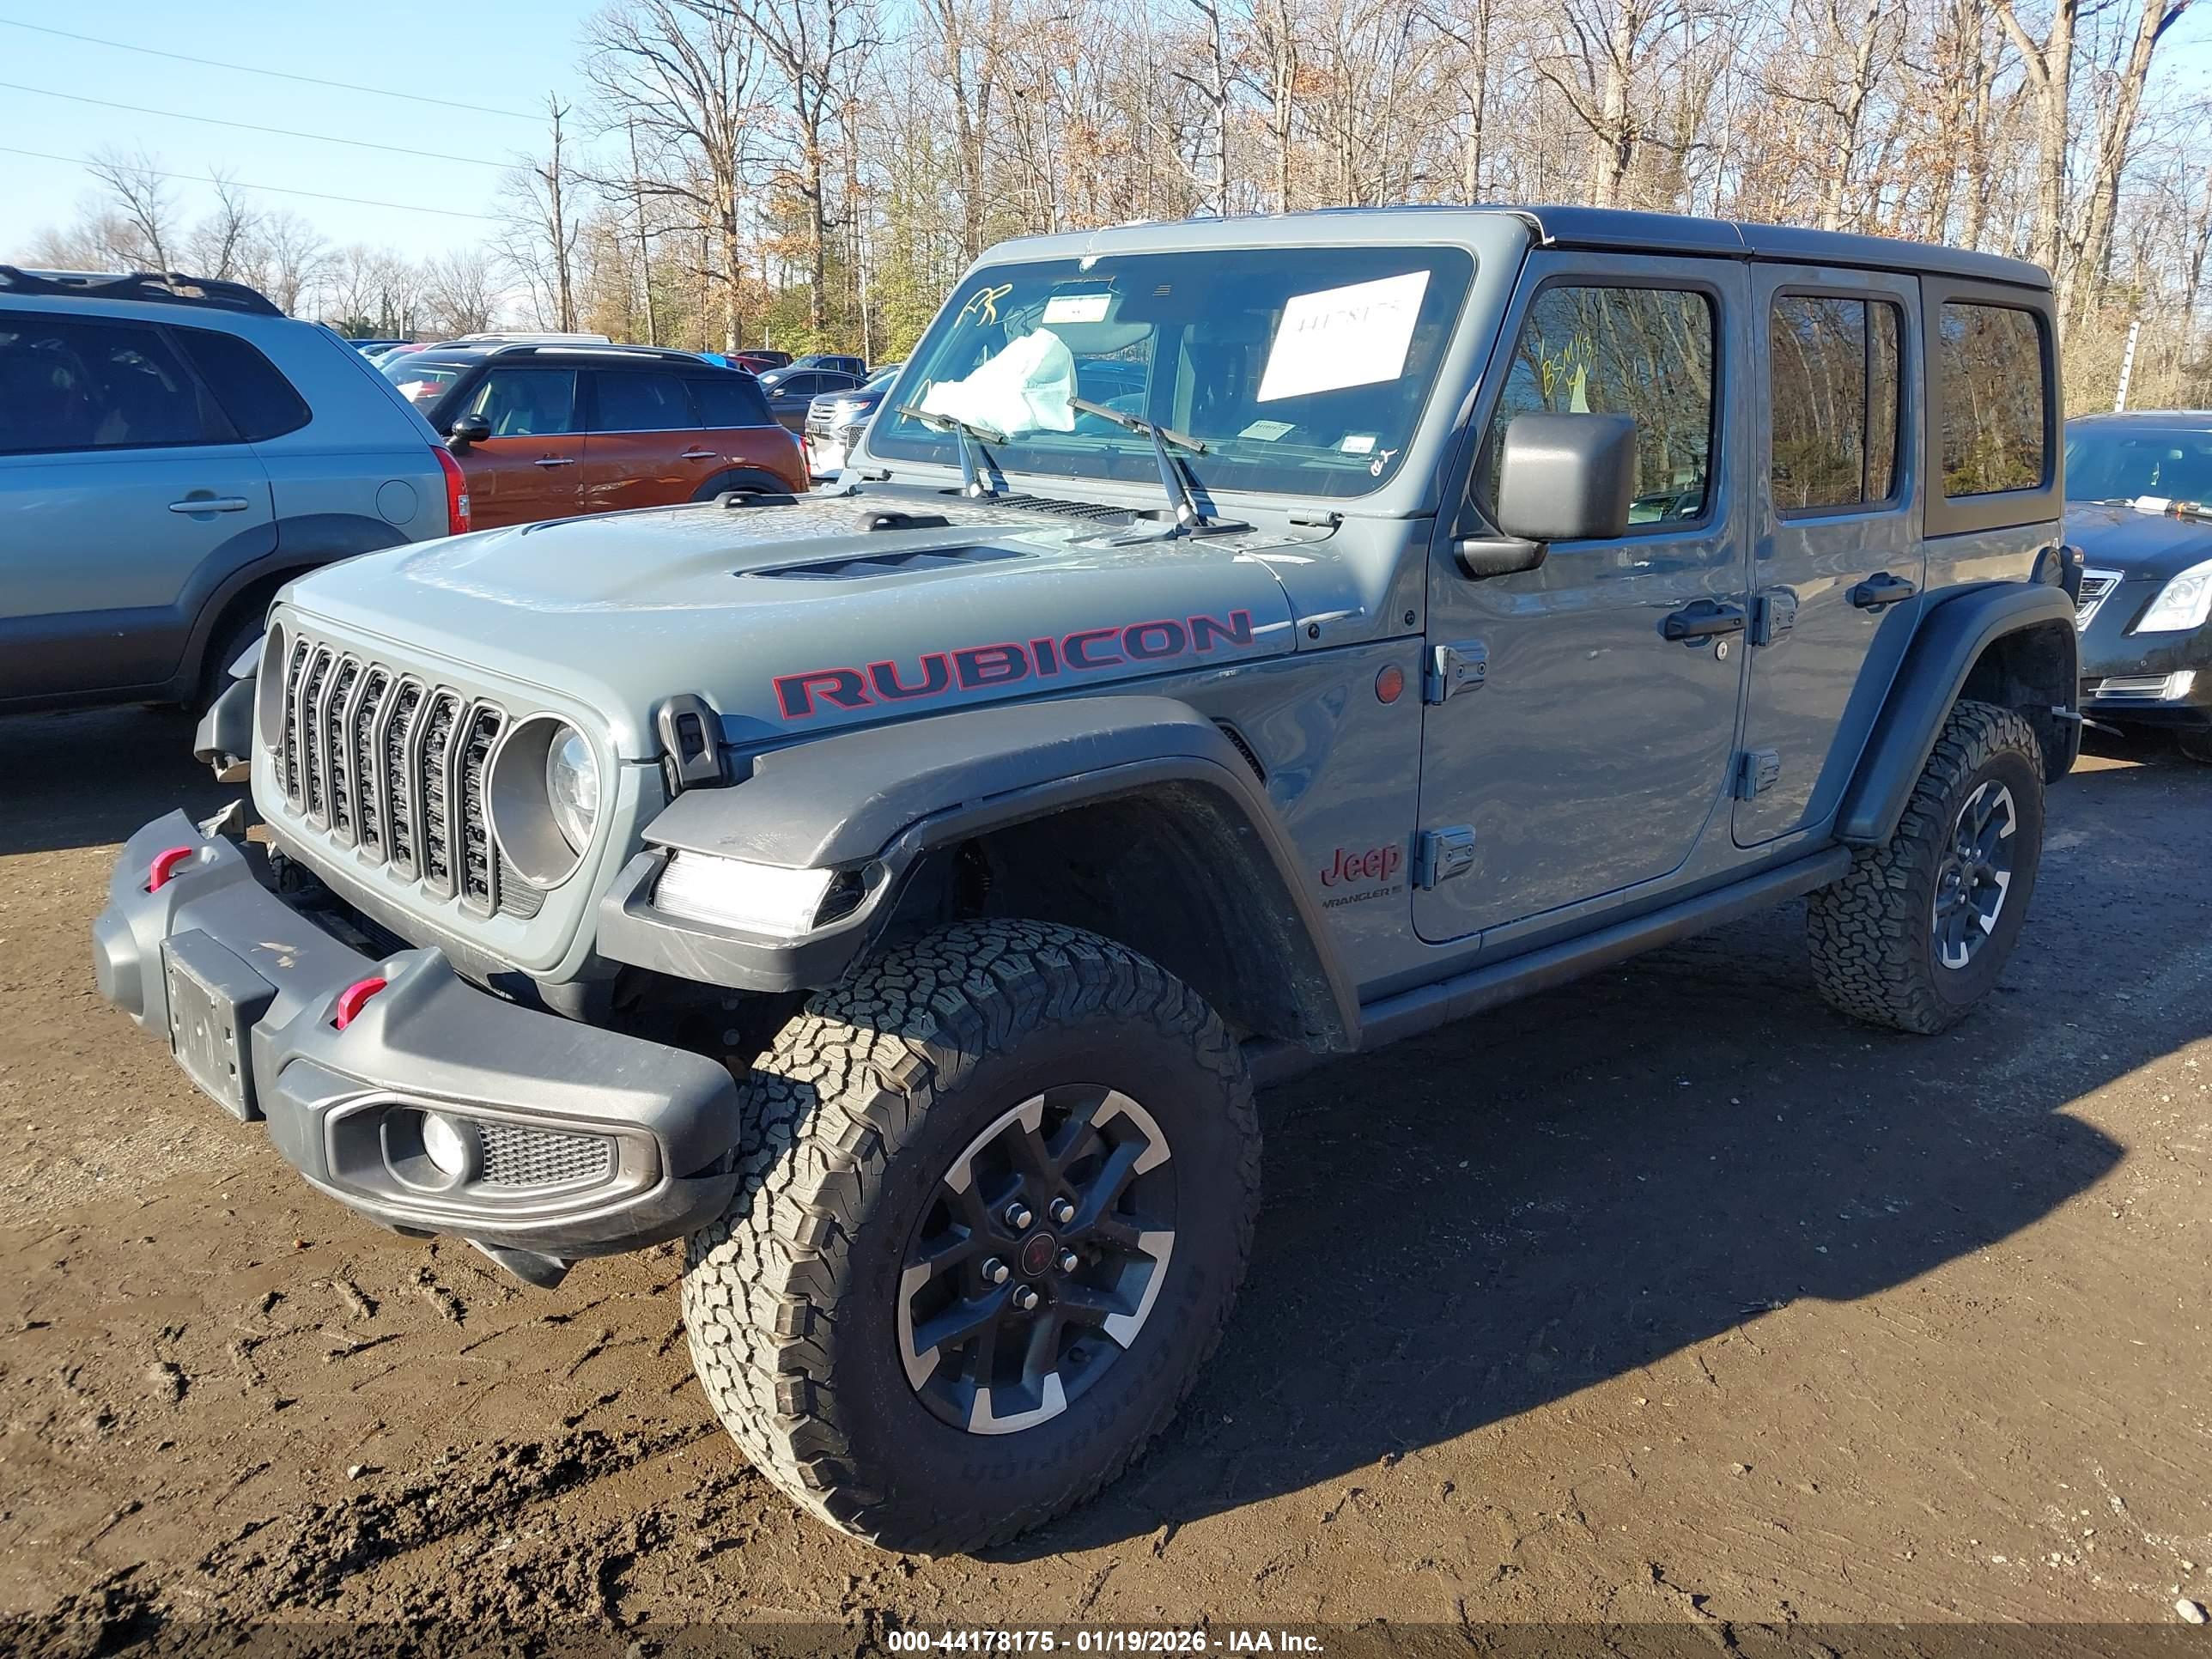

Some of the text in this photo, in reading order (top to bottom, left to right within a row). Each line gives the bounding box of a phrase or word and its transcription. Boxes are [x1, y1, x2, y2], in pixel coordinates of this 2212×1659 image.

[772, 609, 1255, 720] RUBICON
[1321, 845, 1402, 887] Jeep
[1322, 887, 1390, 908] WRANGLER
